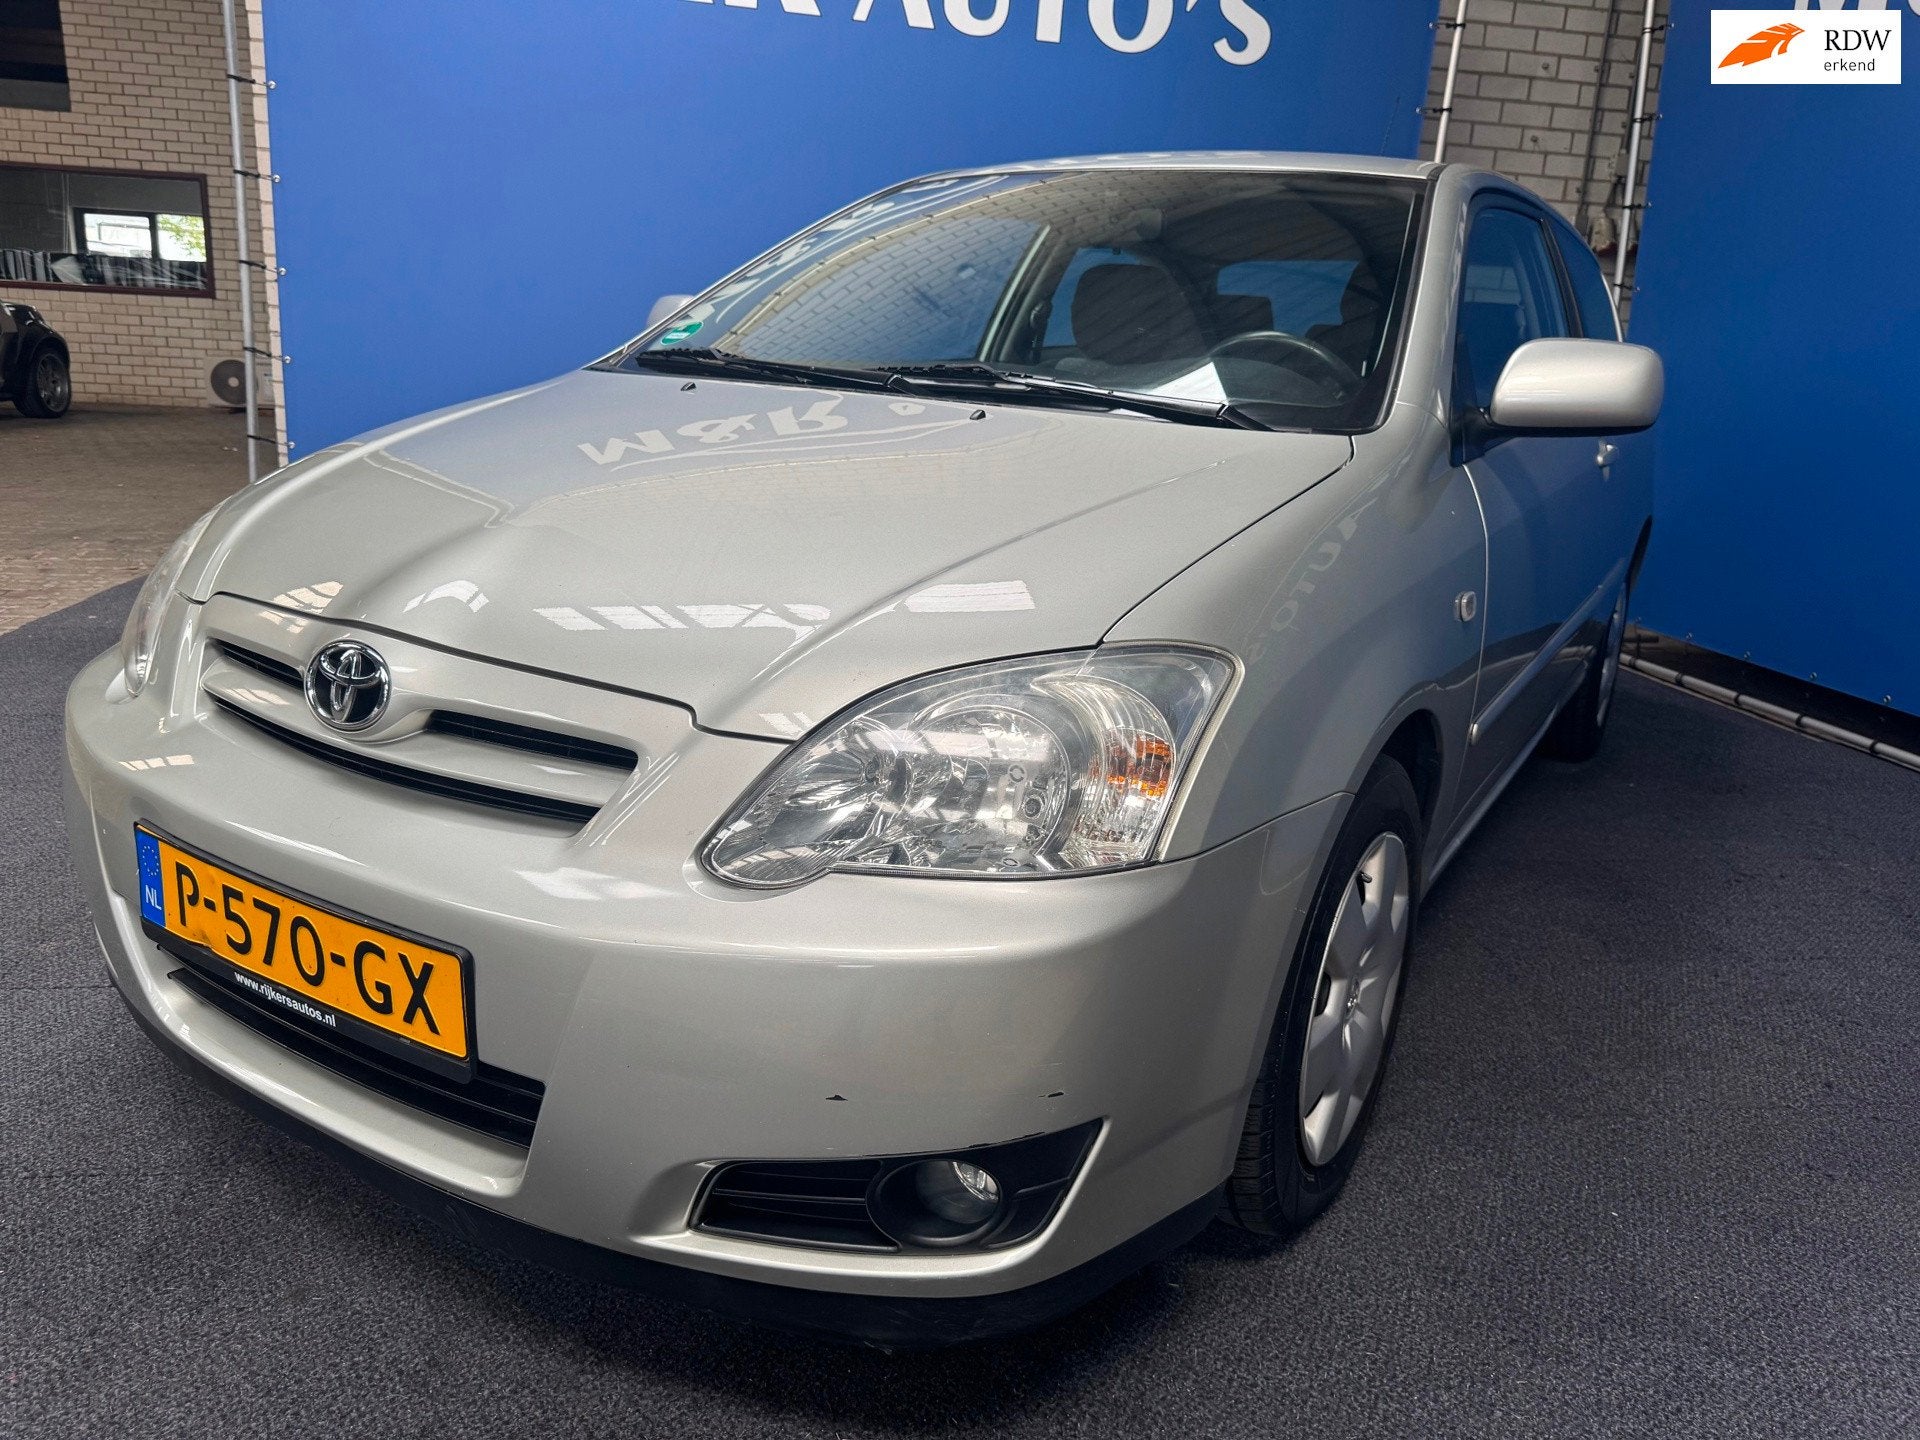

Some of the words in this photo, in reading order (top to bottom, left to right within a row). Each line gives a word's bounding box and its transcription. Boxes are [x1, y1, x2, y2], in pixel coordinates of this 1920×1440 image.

[144, 884, 162, 910] NL
[175, 861, 440, 1036] P-570-GX
[234, 970, 336, 1028] www.rijkersautos.nl
